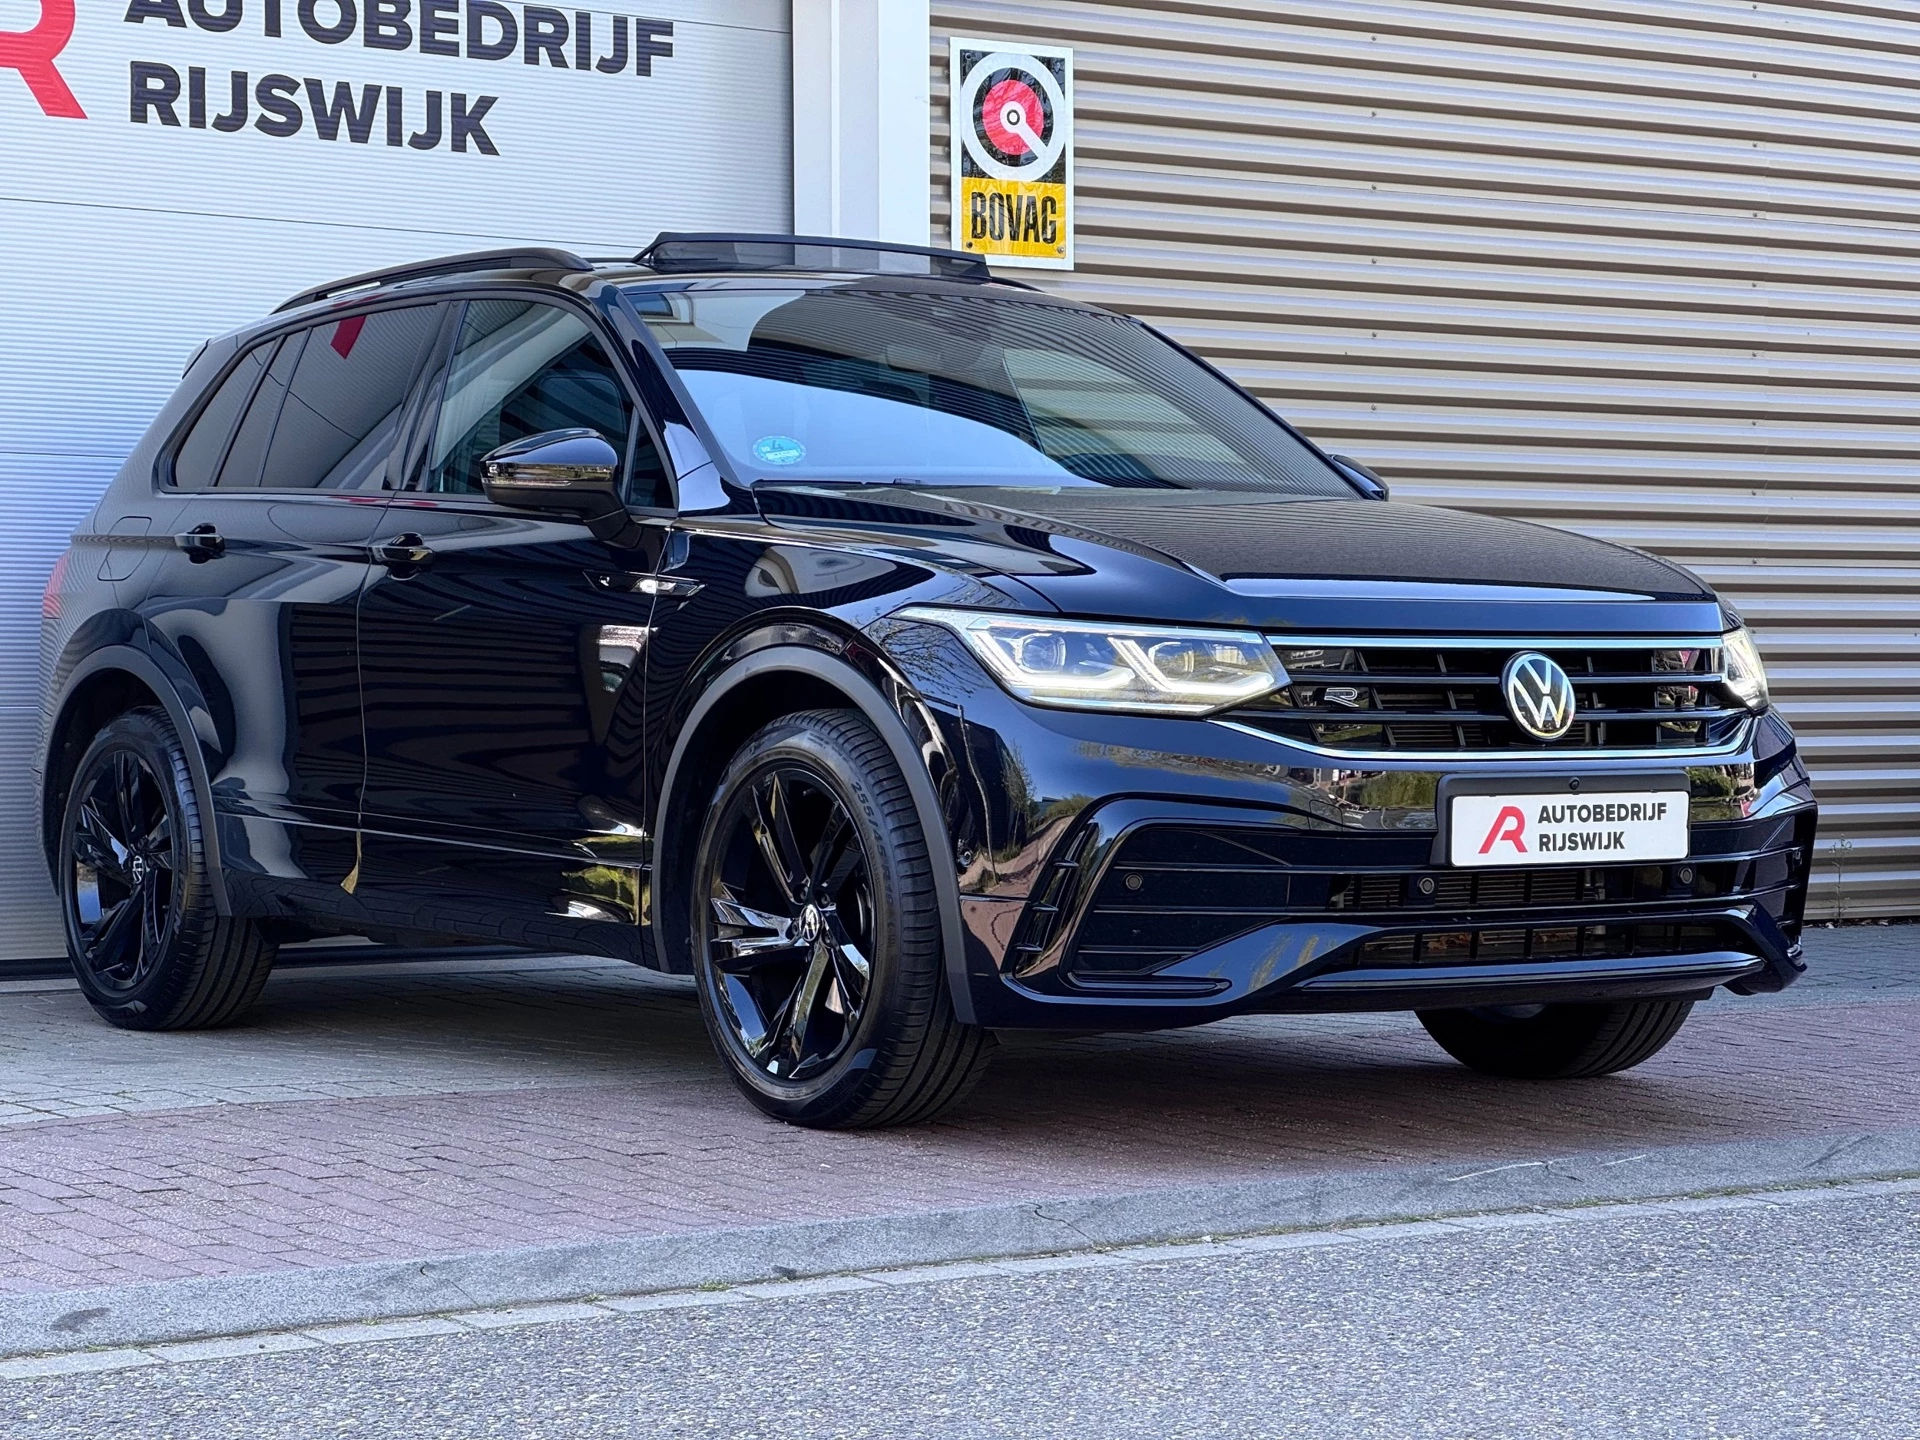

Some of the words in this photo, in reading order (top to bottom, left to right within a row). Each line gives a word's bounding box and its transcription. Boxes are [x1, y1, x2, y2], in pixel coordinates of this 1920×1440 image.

[129, 60, 501, 156] RIJSWIJK
[971, 191, 1057, 244] BOVAG
[1538, 802, 1667, 824] AUTOBEDRIJF
[1538, 831, 1626, 852] RIJSWIJK
